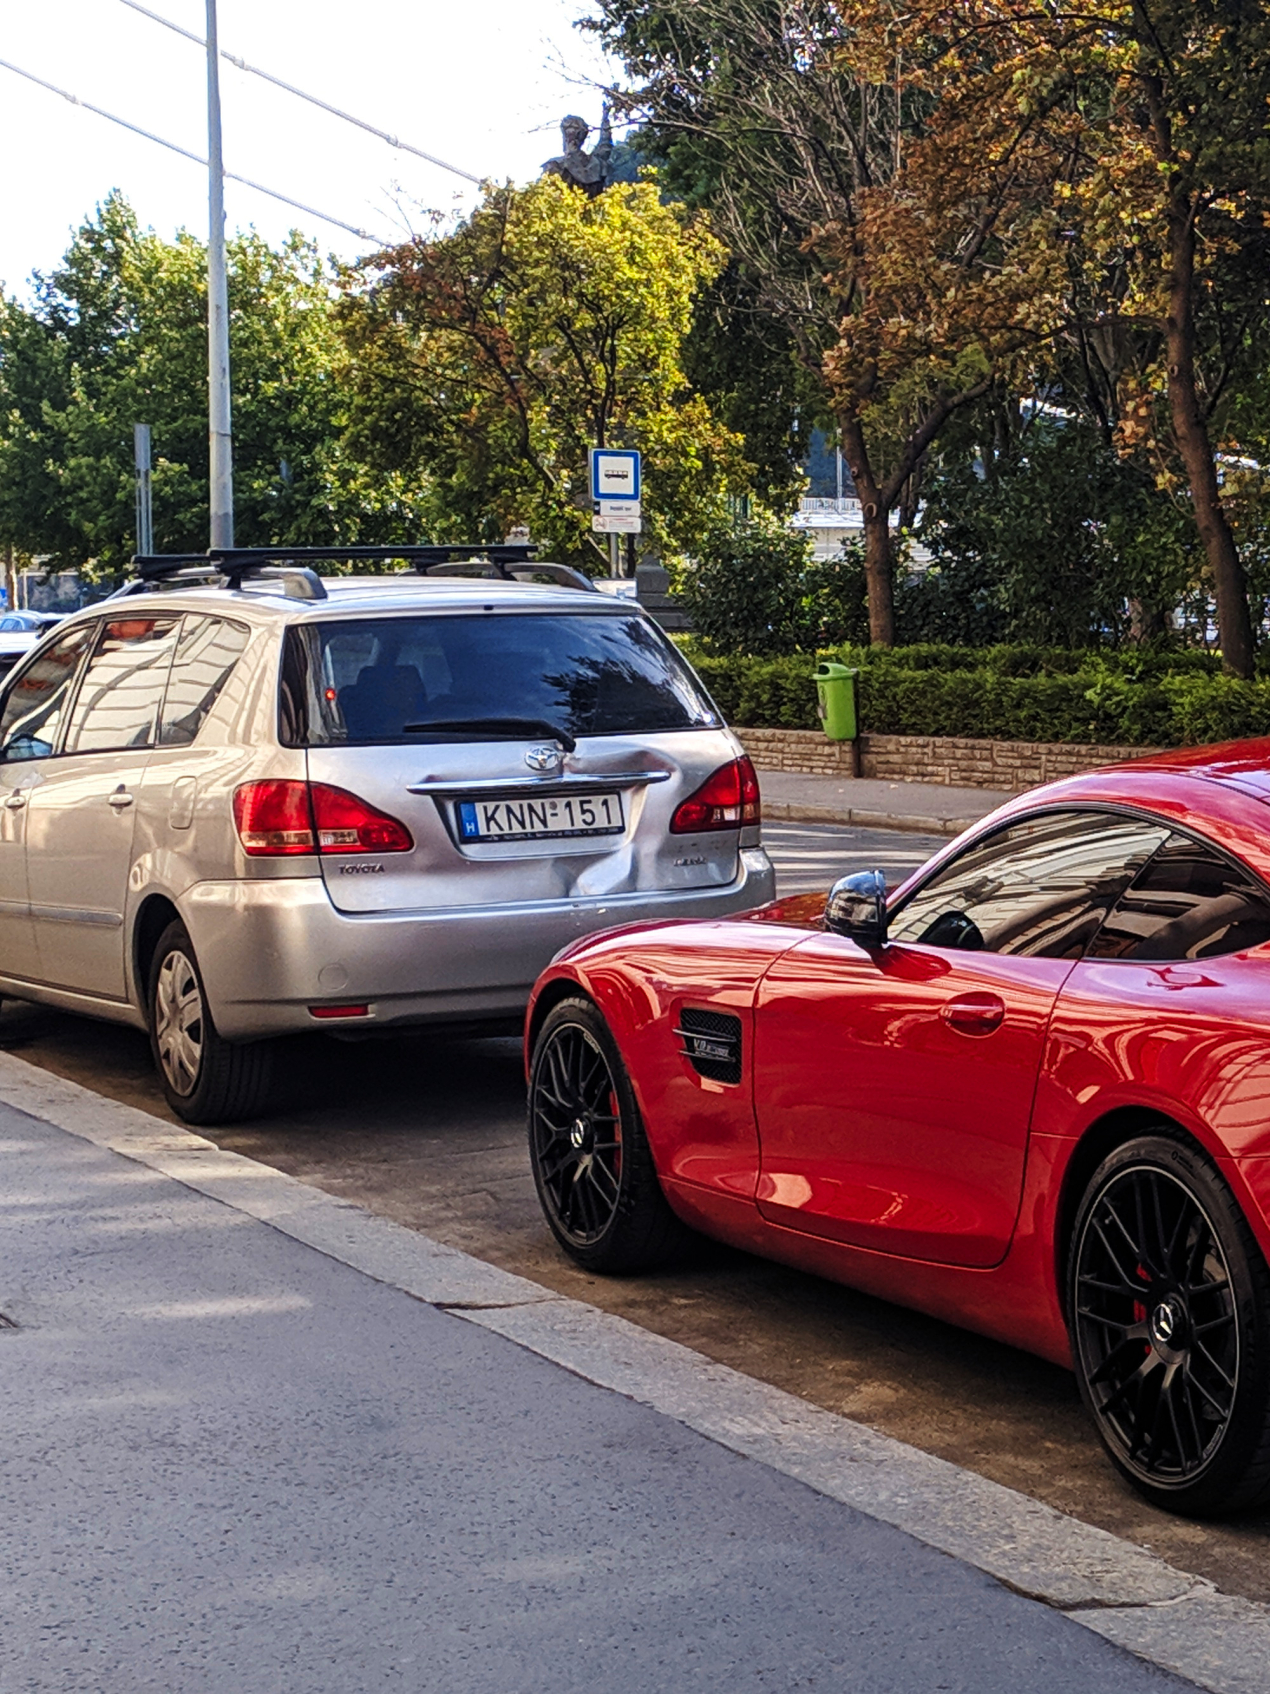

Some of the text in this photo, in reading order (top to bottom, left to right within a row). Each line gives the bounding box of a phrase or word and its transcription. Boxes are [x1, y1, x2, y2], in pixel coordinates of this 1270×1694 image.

[483, 798, 612, 832] KNN-151
[466, 823, 475, 833] H
[339, 864, 385, 874] TOYOTA
